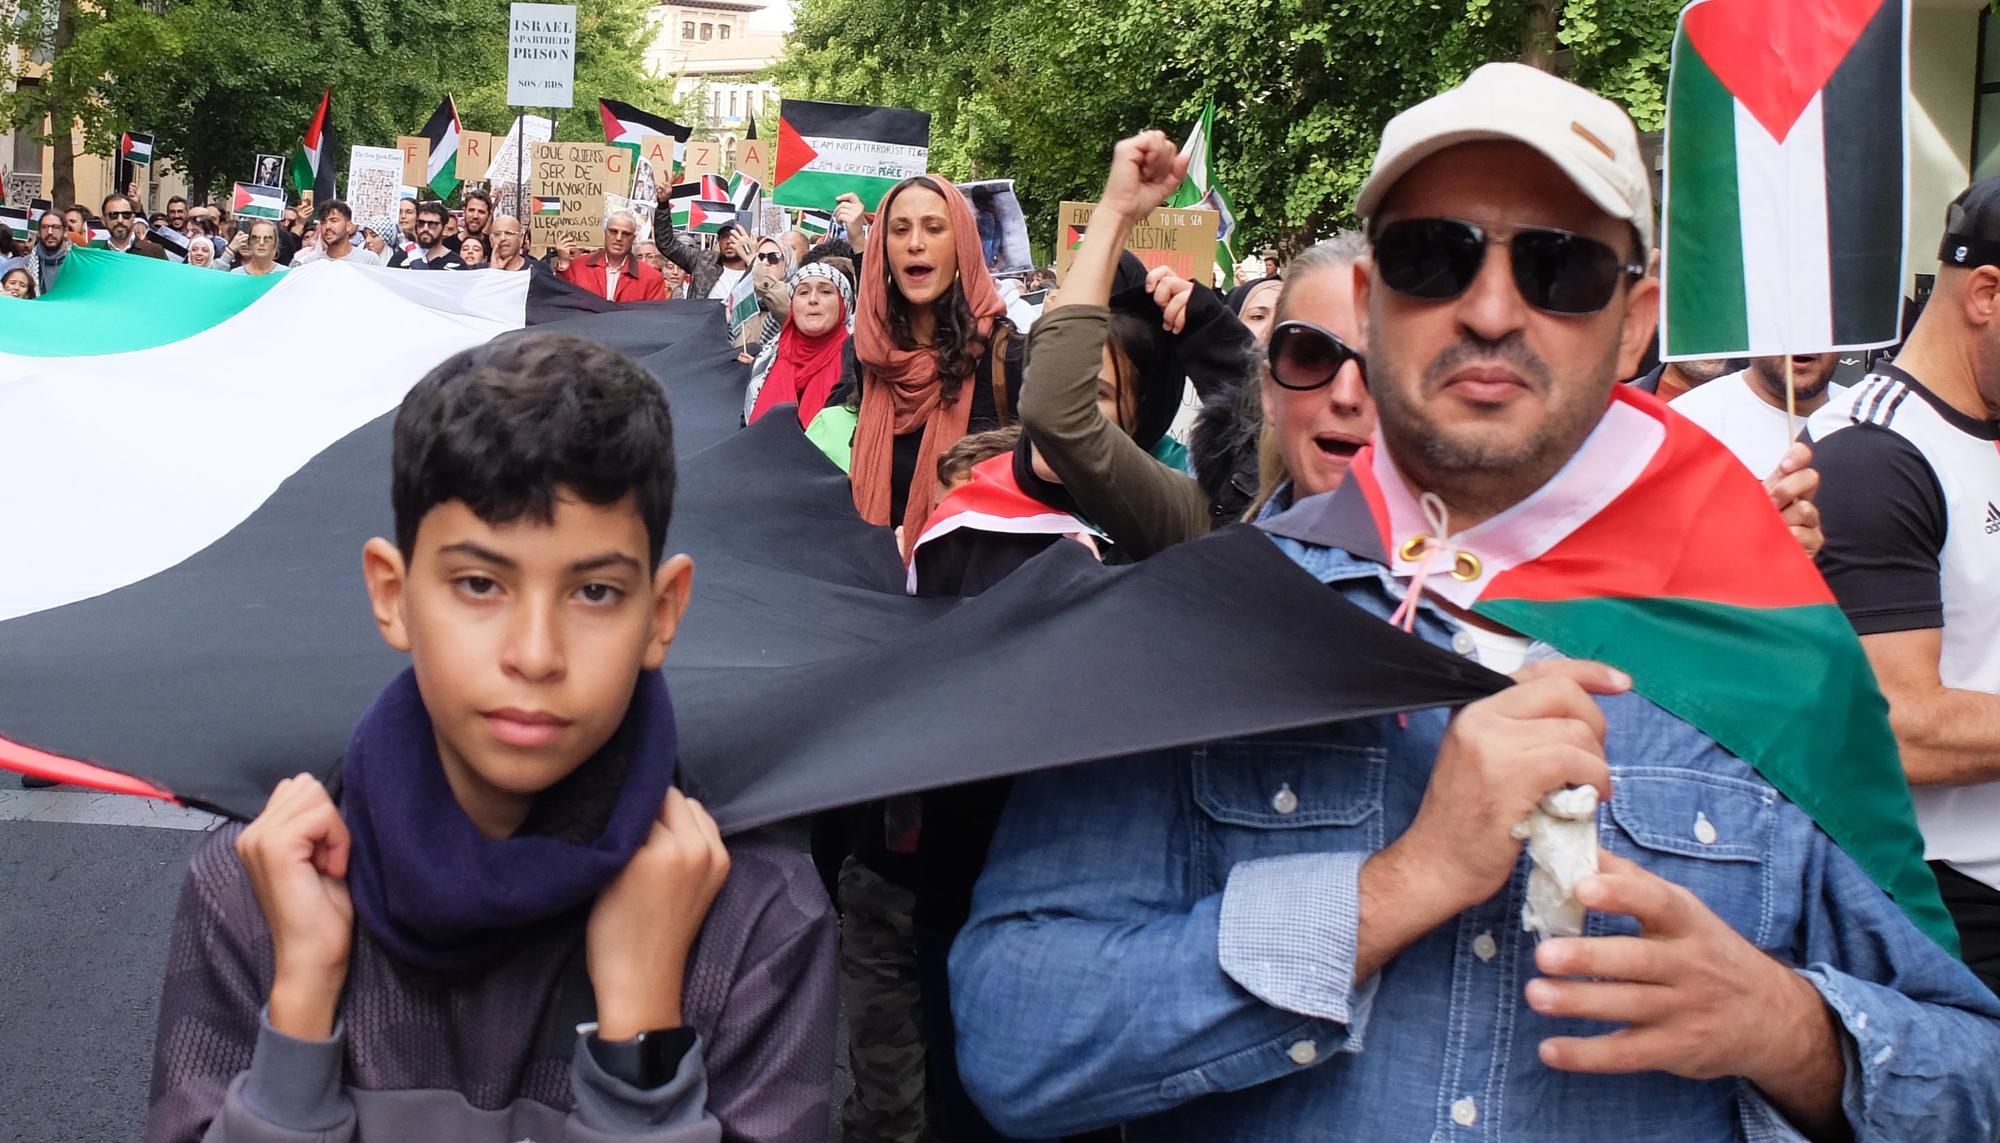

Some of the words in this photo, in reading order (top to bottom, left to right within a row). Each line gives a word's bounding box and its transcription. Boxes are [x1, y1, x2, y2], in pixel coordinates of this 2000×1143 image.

[514, 20, 572, 33] ISRAEL
[513, 35, 570, 45] APARTHEID
[513, 47, 569, 60] PRISON
[467, 138, 479, 157] R
[820, 141, 834, 149] AM
[836, 142, 854, 151] NOT
[407, 146, 418, 164] F
[607, 154, 622, 173] G
[649, 143, 665, 162] A
[696, 148, 709, 166] Z
[744, 146, 760, 164] A
[539, 162, 565, 180] SER
[574, 164, 593, 180] DE
[562, 200, 582, 213] NO
[1160, 213, 1170, 226] TO
[1128, 227, 1178, 250] ALESTINE
